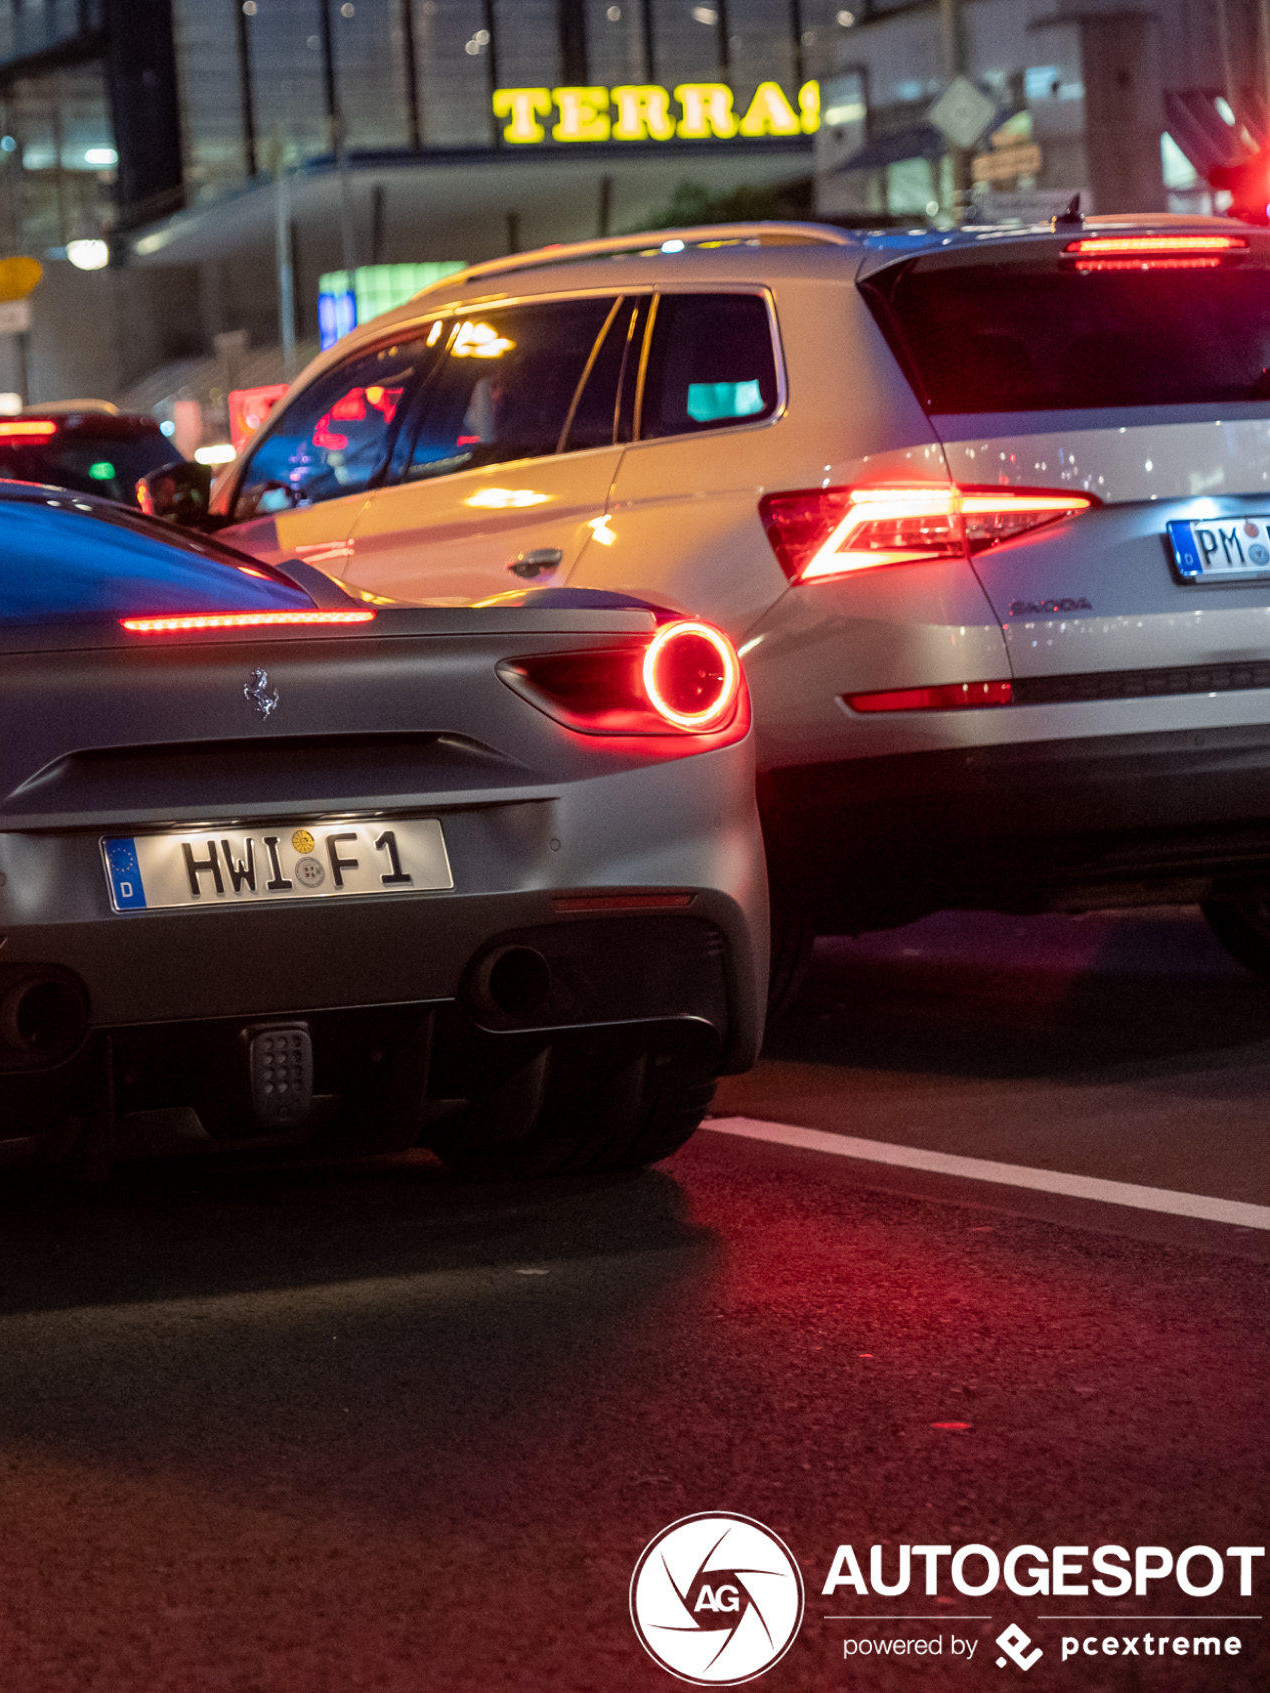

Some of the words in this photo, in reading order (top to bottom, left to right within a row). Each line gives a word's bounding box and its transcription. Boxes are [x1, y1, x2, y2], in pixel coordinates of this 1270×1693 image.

[1195, 527, 1246, 567] PM
[120, 882, 134, 899] D
[181, 836, 293, 896] HWI
